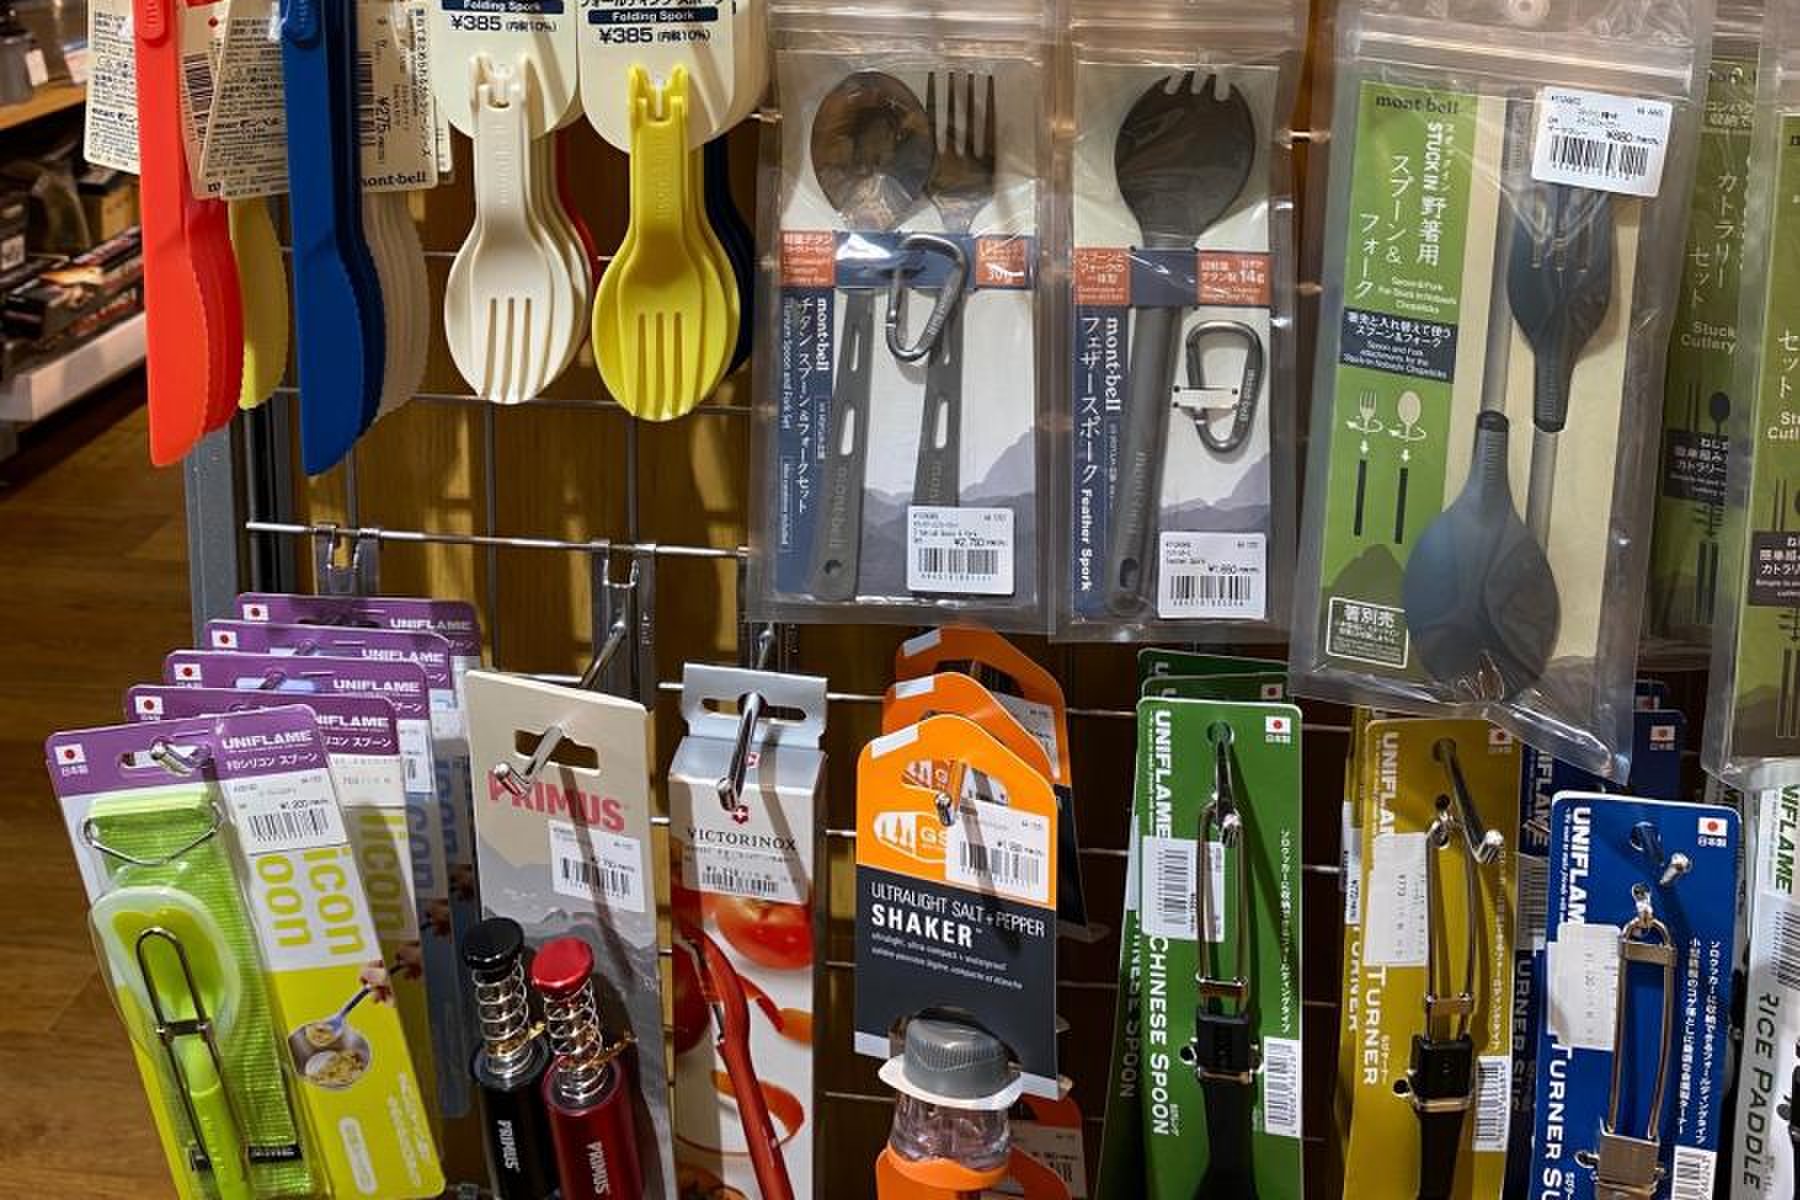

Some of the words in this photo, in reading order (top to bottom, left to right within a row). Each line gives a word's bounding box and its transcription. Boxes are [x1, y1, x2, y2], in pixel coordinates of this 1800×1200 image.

[450, 15, 503, 31] ¥385
[599, 27, 653, 44] ¥385
[611, 10, 657, 23] Folding
[659, 8, 695, 22] Spork
[1424, 121, 1444, 173] STUCK
[1354, 212, 1380, 299] フォーク
[1767, 426, 1800, 440] Cutl
[1080, 488, 1094, 545] Feather
[1079, 548, 1094, 592] Spork
[390, 618, 473, 631] UNIFLAME
[362, 649, 445, 663] UNIFLAME
[333, 679, 420, 693] UNIFLAME
[222, 730, 314, 750] UNIFLAME
[279, 753, 318, 766] スプーン
[488, 766, 626, 833] PRIMUS
[1154, 710, 1173, 838] UNIFLAME
[686, 827, 797, 851] VICTORINOX
[1569, 806, 1592, 922] UNIFLAM
[256, 856, 311, 949] oon
[302, 846, 366, 956] icon
[871, 881, 948, 915] ULTRALIGHT
[951, 900, 986, 924] SALT
[996, 911, 1046, 939] PEPPER
[1147, 937, 1170, 1046] CHINESE
[1362, 965, 1387, 1086] TURNER
[1147, 1052, 1170, 1137] SPOON
[1547, 1043, 1575, 1160] TURNER
[496, 1119, 519, 1172] PRIMUS
[1743, 1065, 1775, 1191] PADDLE
[586, 1141, 611, 1196] PRIMUS
